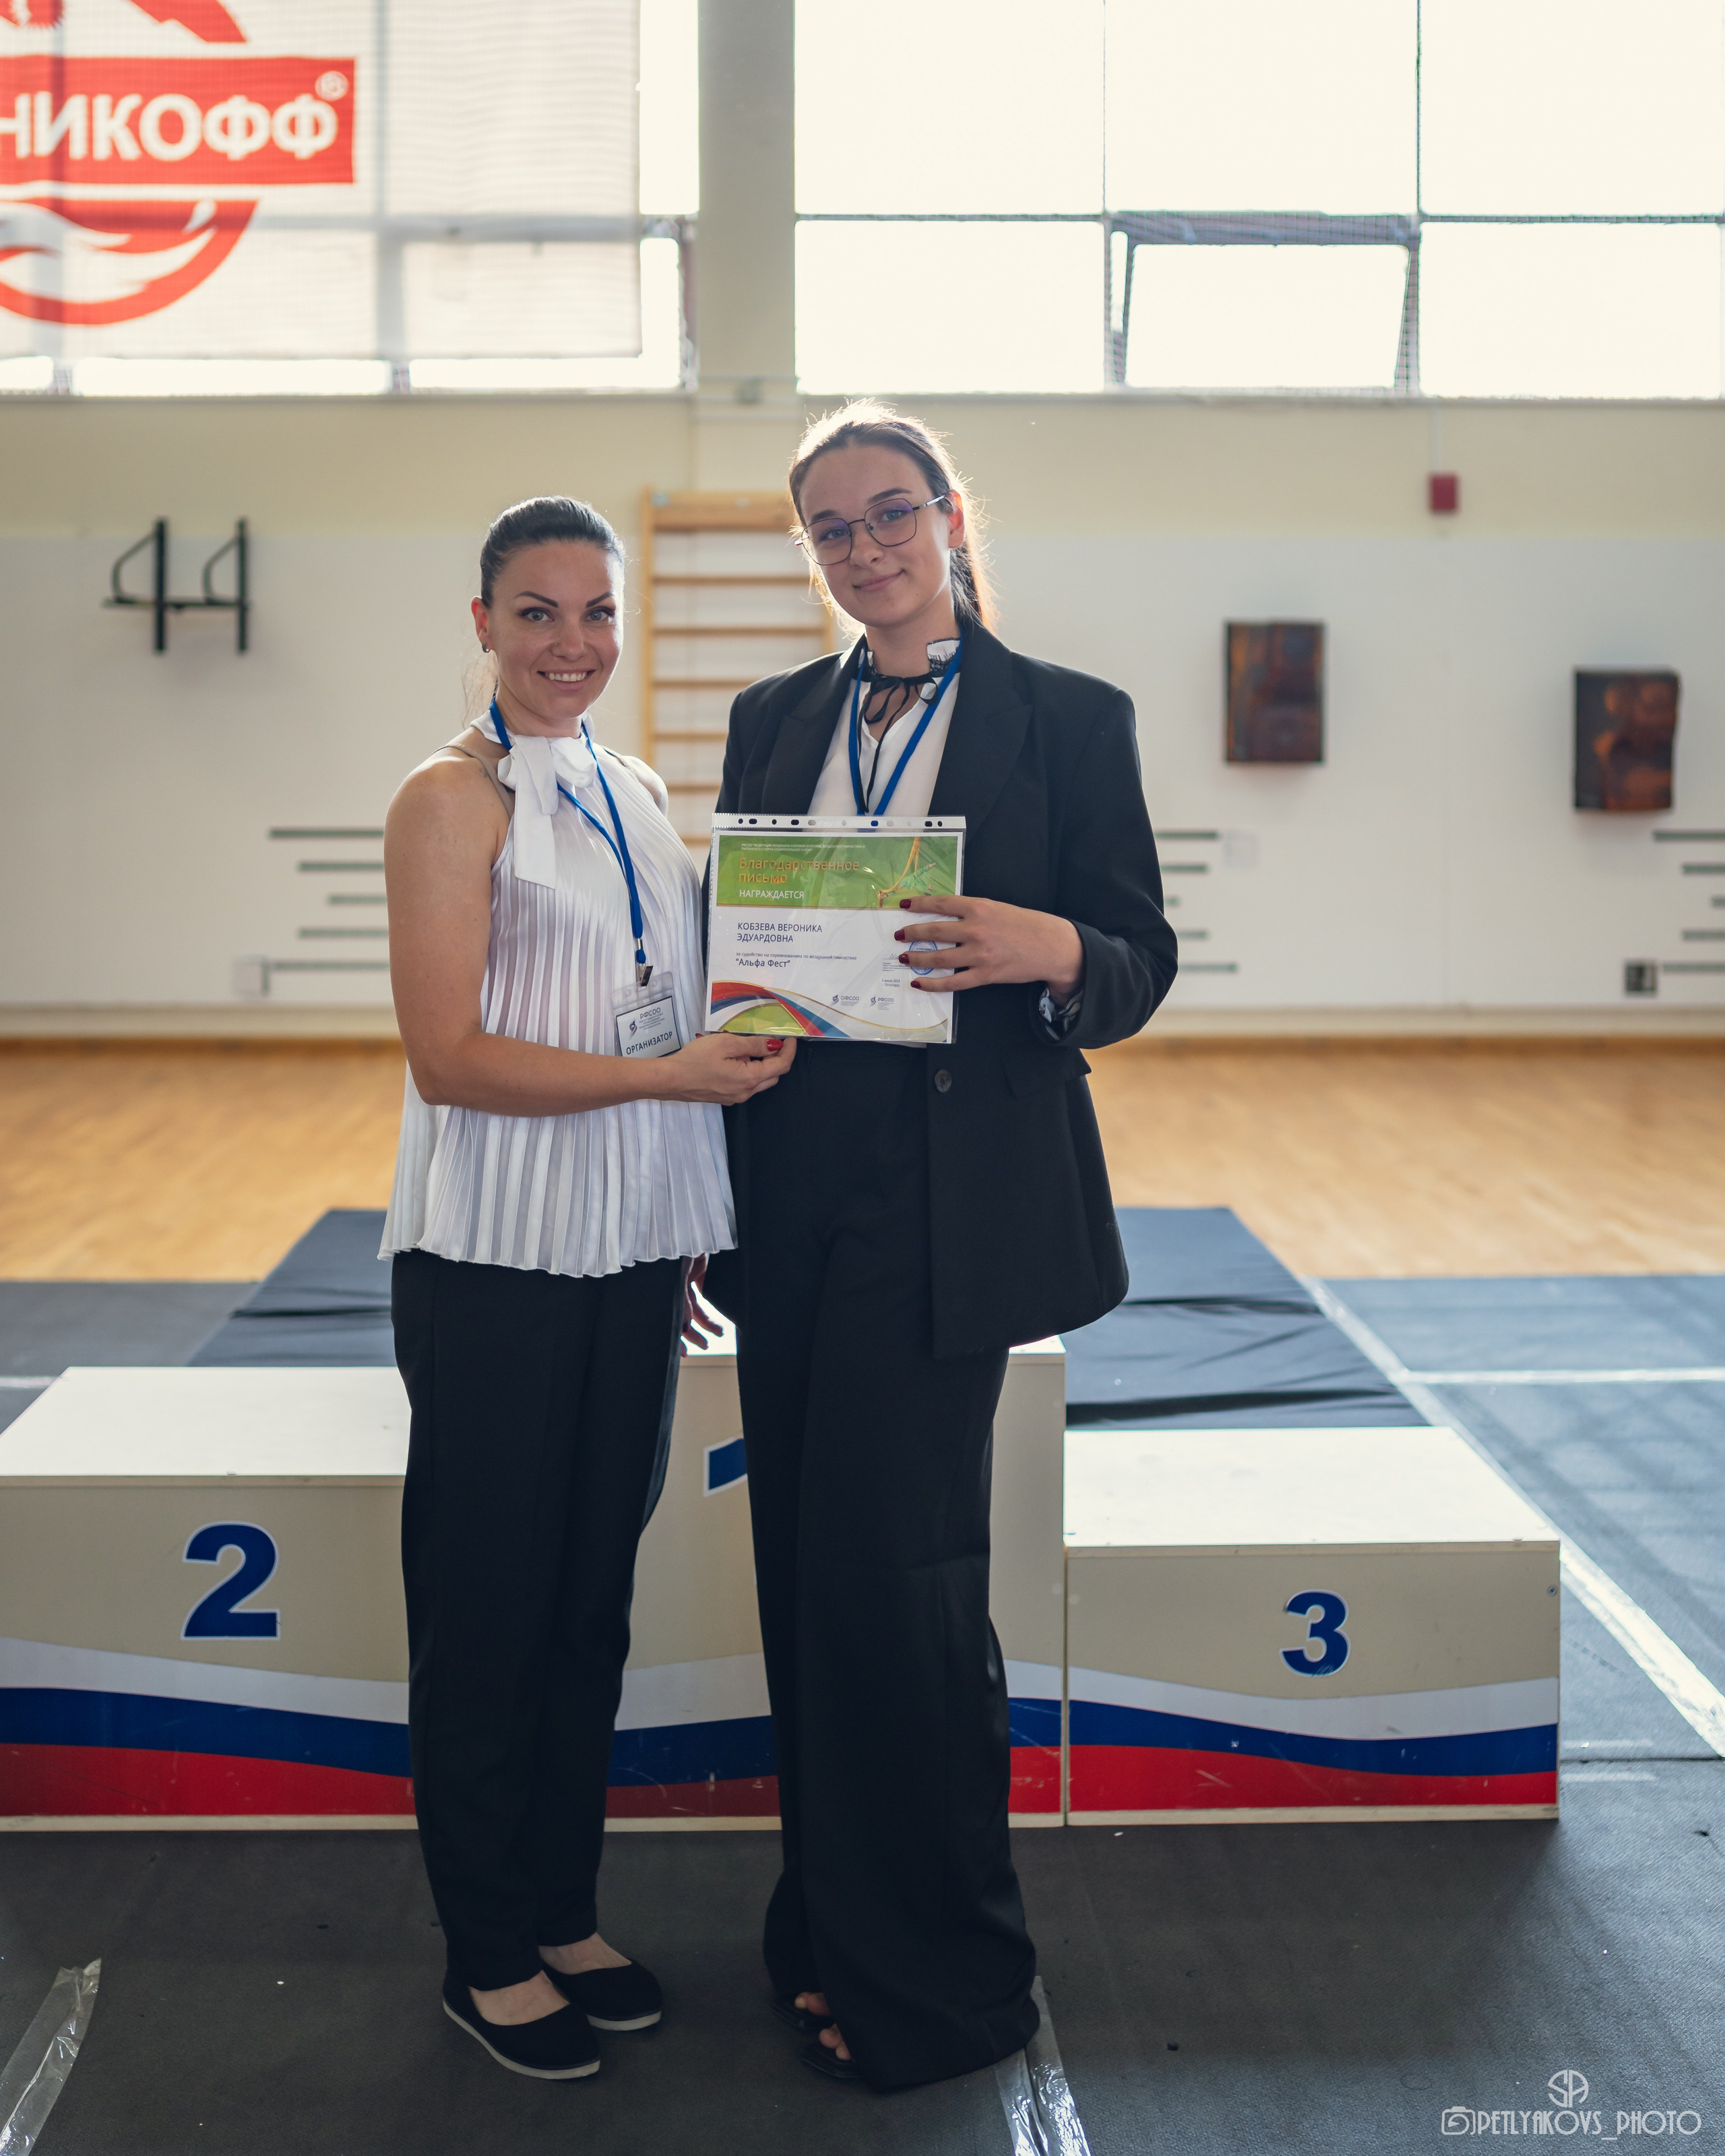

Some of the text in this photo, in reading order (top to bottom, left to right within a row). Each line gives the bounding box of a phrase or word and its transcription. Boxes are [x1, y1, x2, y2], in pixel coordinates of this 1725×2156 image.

[739, 857, 860, 872] Благодарственное
[739, 873, 788, 883] письмо
[739, 889, 805, 899] НАГРАЖДАЕТСЯ
[738, 922, 823, 932] КОБЗЕВА ВЕРОНИКА
[736, 933, 794, 943] ЭДУАРДОВНА
[639, 1007, 661, 1019] РФСОО
[626, 1031, 672, 1055] ОРГАНИЗАТОР
[183, 1521, 281, 1641] 2
[1279, 1589, 1352, 1677] 3
